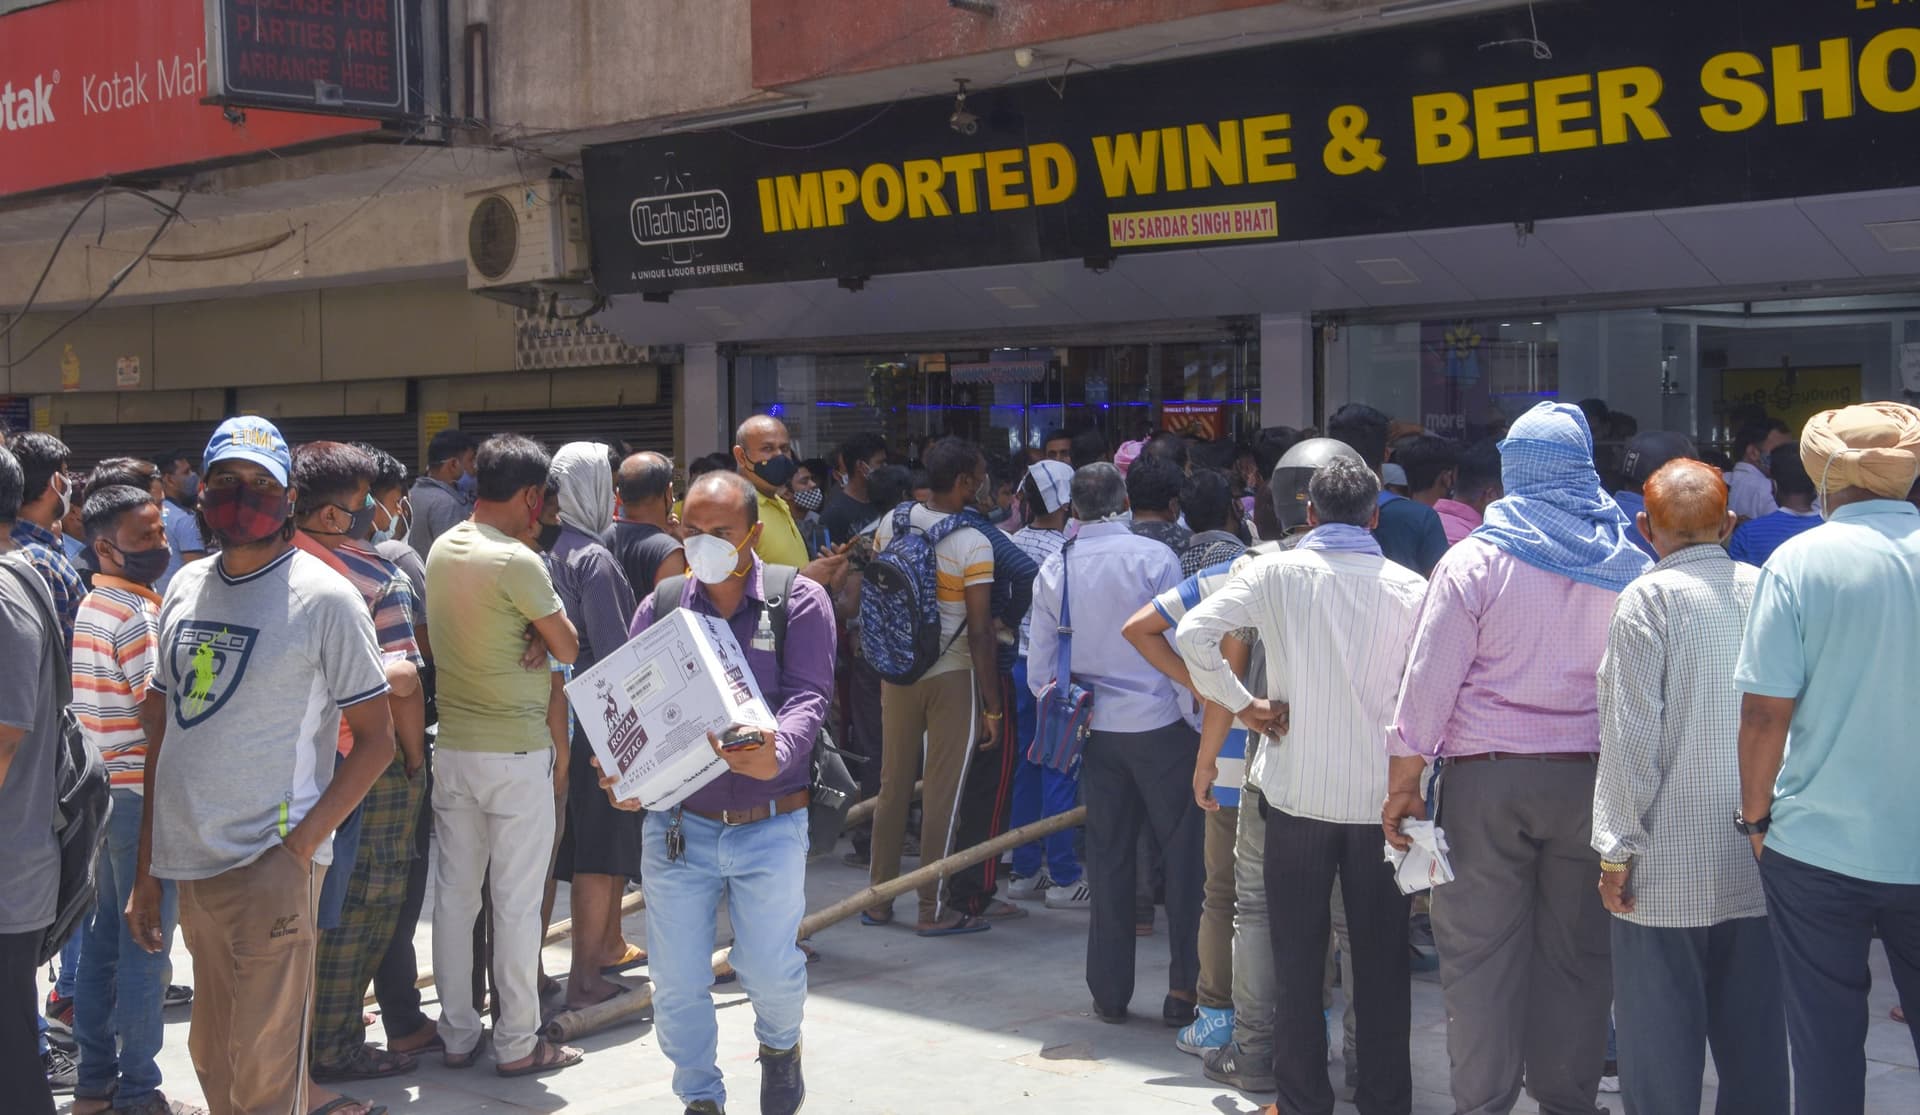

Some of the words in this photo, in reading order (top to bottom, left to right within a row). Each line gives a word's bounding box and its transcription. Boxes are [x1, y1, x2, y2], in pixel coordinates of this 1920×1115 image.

[237, 15, 336, 52] PARTIES
[344, 27, 391, 57] ARE
[82, 61, 150, 116] Kotak
[239, 51, 330, 81] ARRANGE
[342, 63, 391, 92] HERE
[757, 142, 1077, 233] IMPORTED
[1092, 113, 1296, 198] WINE
[1323, 104, 1387, 176] &
[1412, 65, 1672, 166] BEER
[1700, 27, 1920, 133] SHO
[636, 197, 726, 237] Madhushala
[1112, 217, 1136, 242] M/S
[1139, 214, 1190, 239] SARDAR
[1191, 210, 1232, 236] SINGH
[1235, 207, 1275, 233] BHATI
[631, 271, 637, 280] A
[638, 268, 666, 280] UNIQUE
[668, 266, 696, 277] LIQUOR
[697, 262, 745, 275] EXPERIENCE
[181, 630, 245, 648] POLO
[610, 714, 636, 749] ROYAL
[622, 737, 643, 767] STAG
